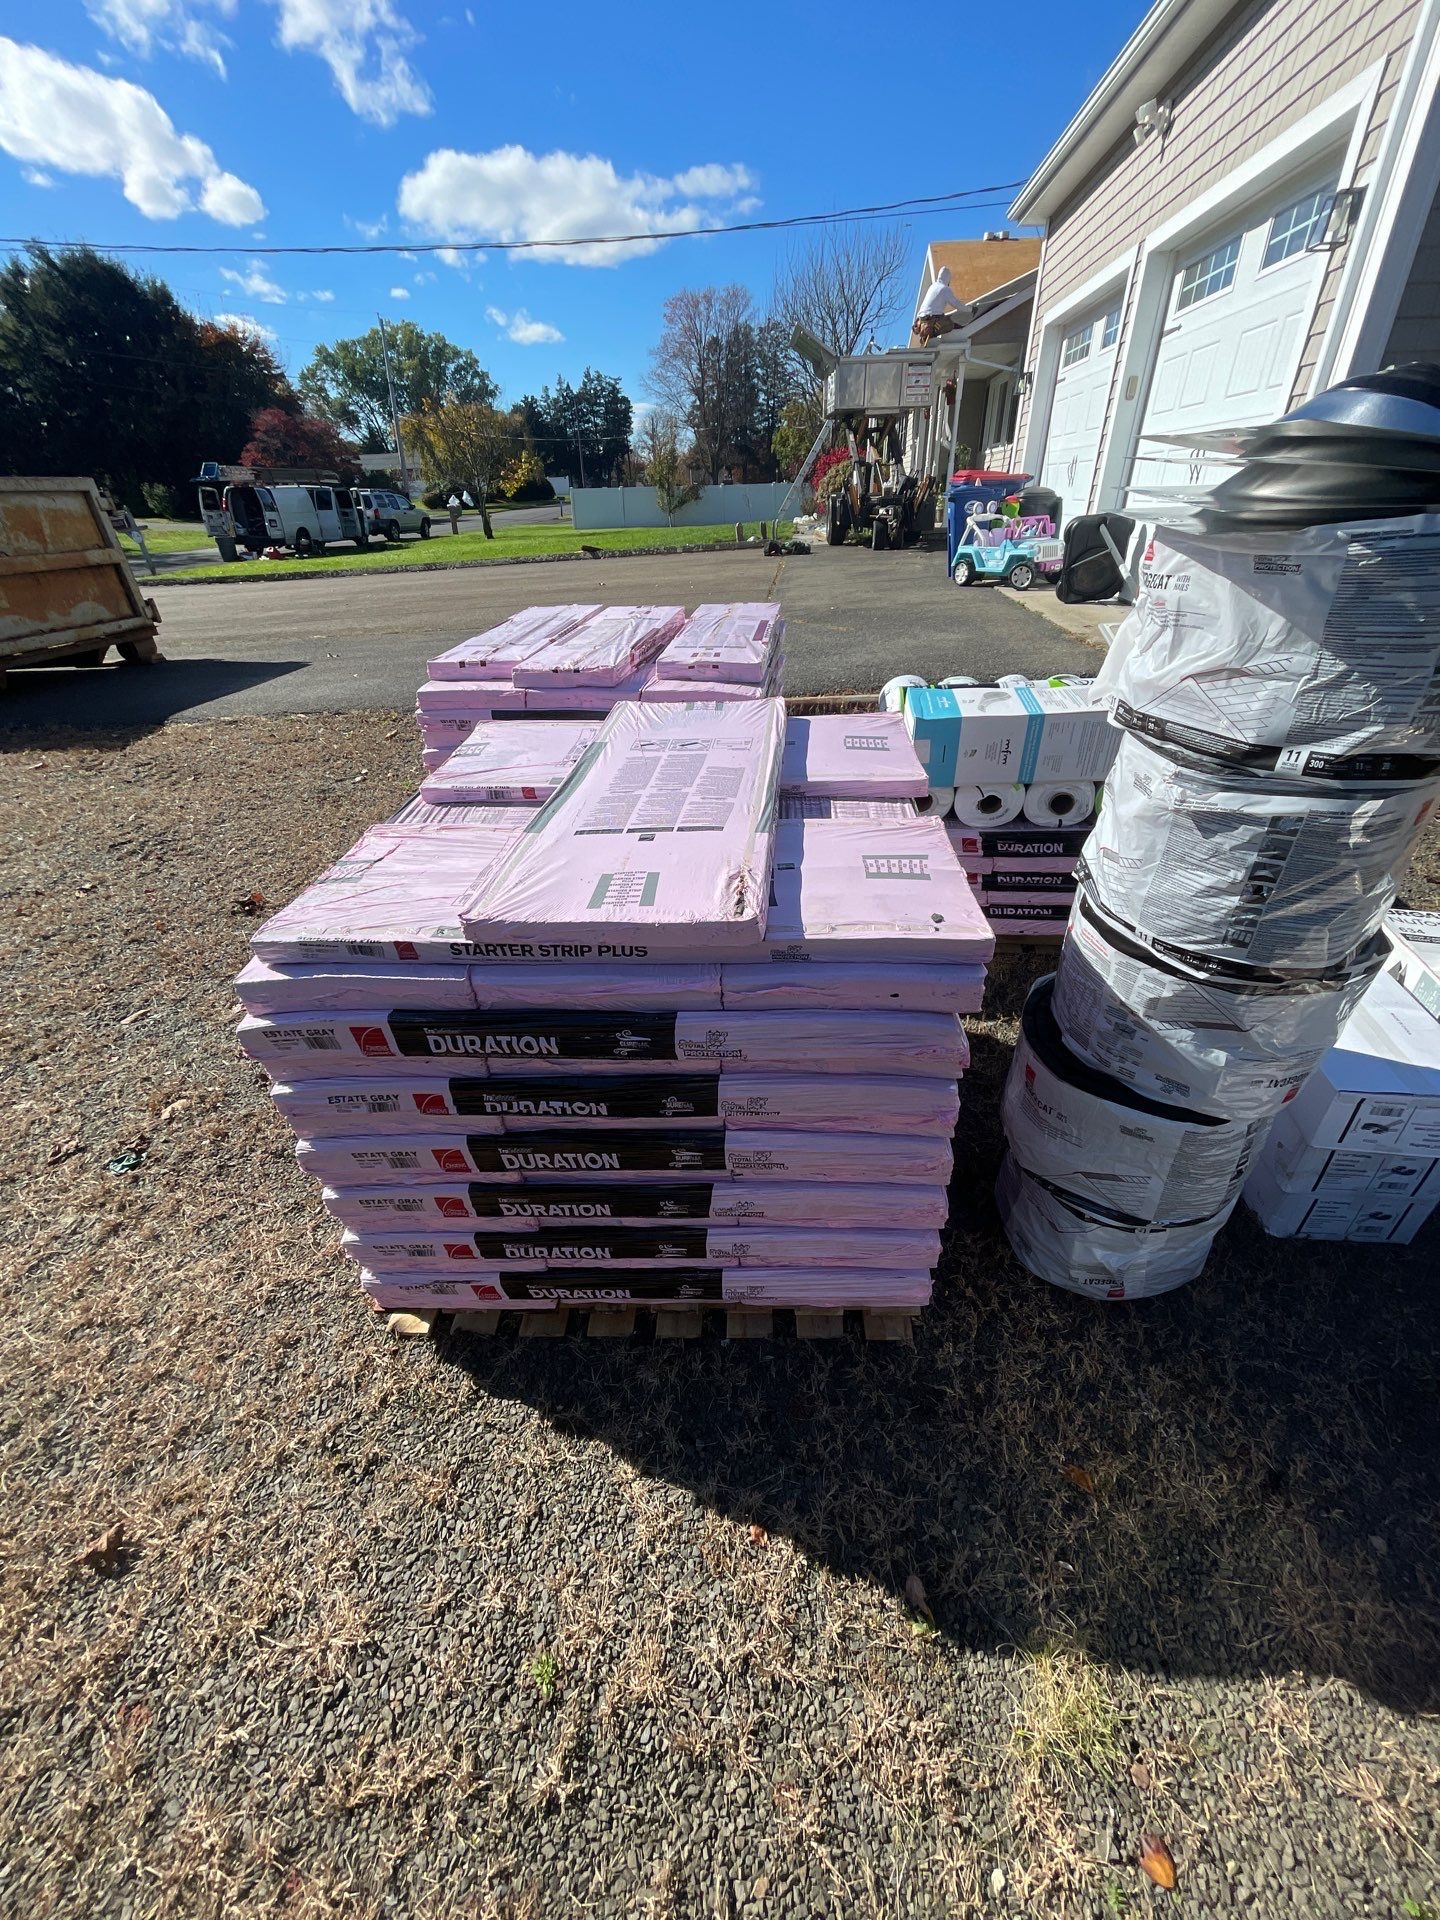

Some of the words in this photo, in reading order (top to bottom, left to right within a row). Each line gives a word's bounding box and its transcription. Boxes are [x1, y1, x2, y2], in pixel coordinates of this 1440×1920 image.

[1000, 739, 1011, 764] mfm
[1286, 750, 1302, 762] 11
[1308, 760, 1324, 768] 300
[998, 843, 1063, 853] DURATION
[998, 876, 1062, 884] DURATION
[1138, 932, 1148, 942] 11
[450, 942, 534, 956] STARTER
[538, 944, 592, 957] STRIP
[596, 944, 648, 958] PLUS
[262, 1029, 304, 1038] ESTATE
[306, 1028, 336, 1037] GRAY
[426, 1035, 560, 1054] DURATION
[328, 1094, 368, 1104] ESTATE
[370, 1094, 400, 1102] GRAY
[484, 1101, 608, 1115] DURATION
[500, 1153, 619, 1169] DURATION
[500, 1204, 612, 1216] DURATION
[505, 1248, 610, 1258] DURATION
[528, 1289, 631, 1298] DURATION
